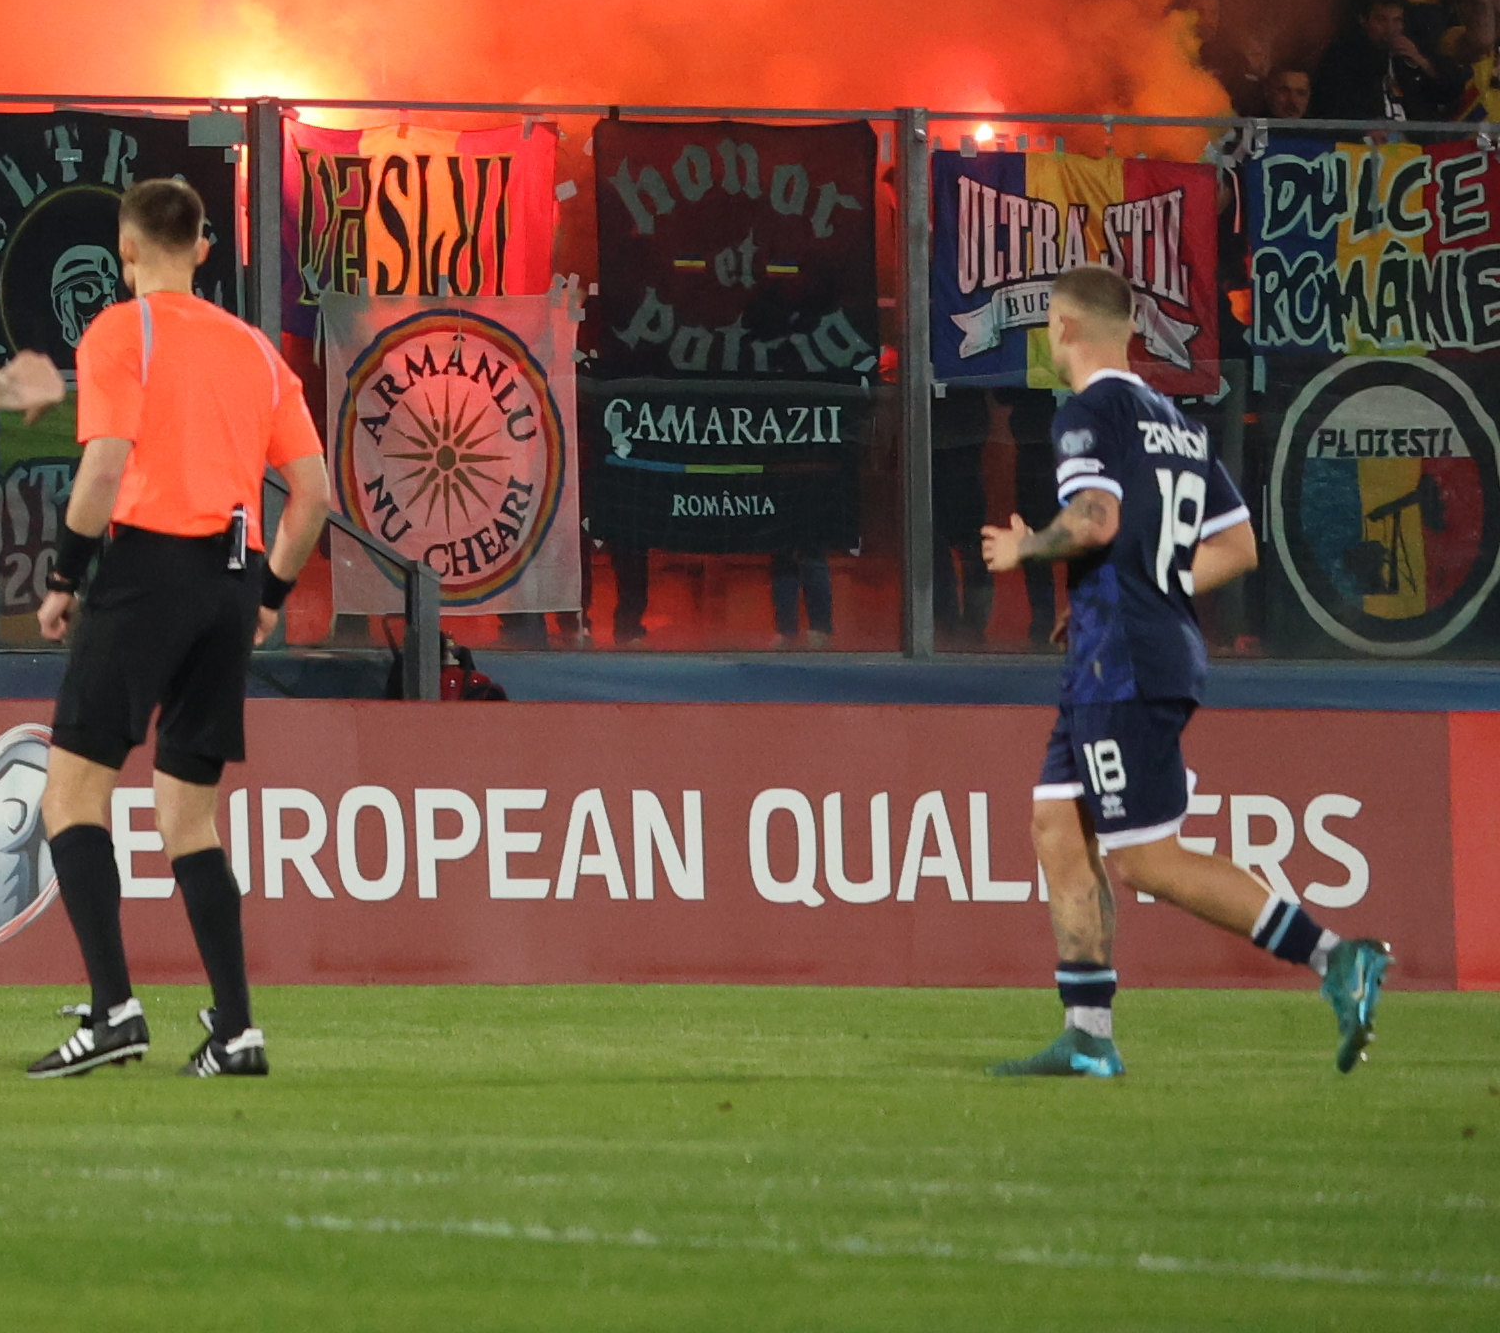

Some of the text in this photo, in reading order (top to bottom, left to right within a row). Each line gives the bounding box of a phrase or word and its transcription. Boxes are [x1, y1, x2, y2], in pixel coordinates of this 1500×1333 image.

[1261, 150, 1490, 244] DULCE
[363, 474, 534, 577] NU CHEARI
[671, 489, 776, 517] ROMÂNIA
[1082, 738, 1128, 796] 18
